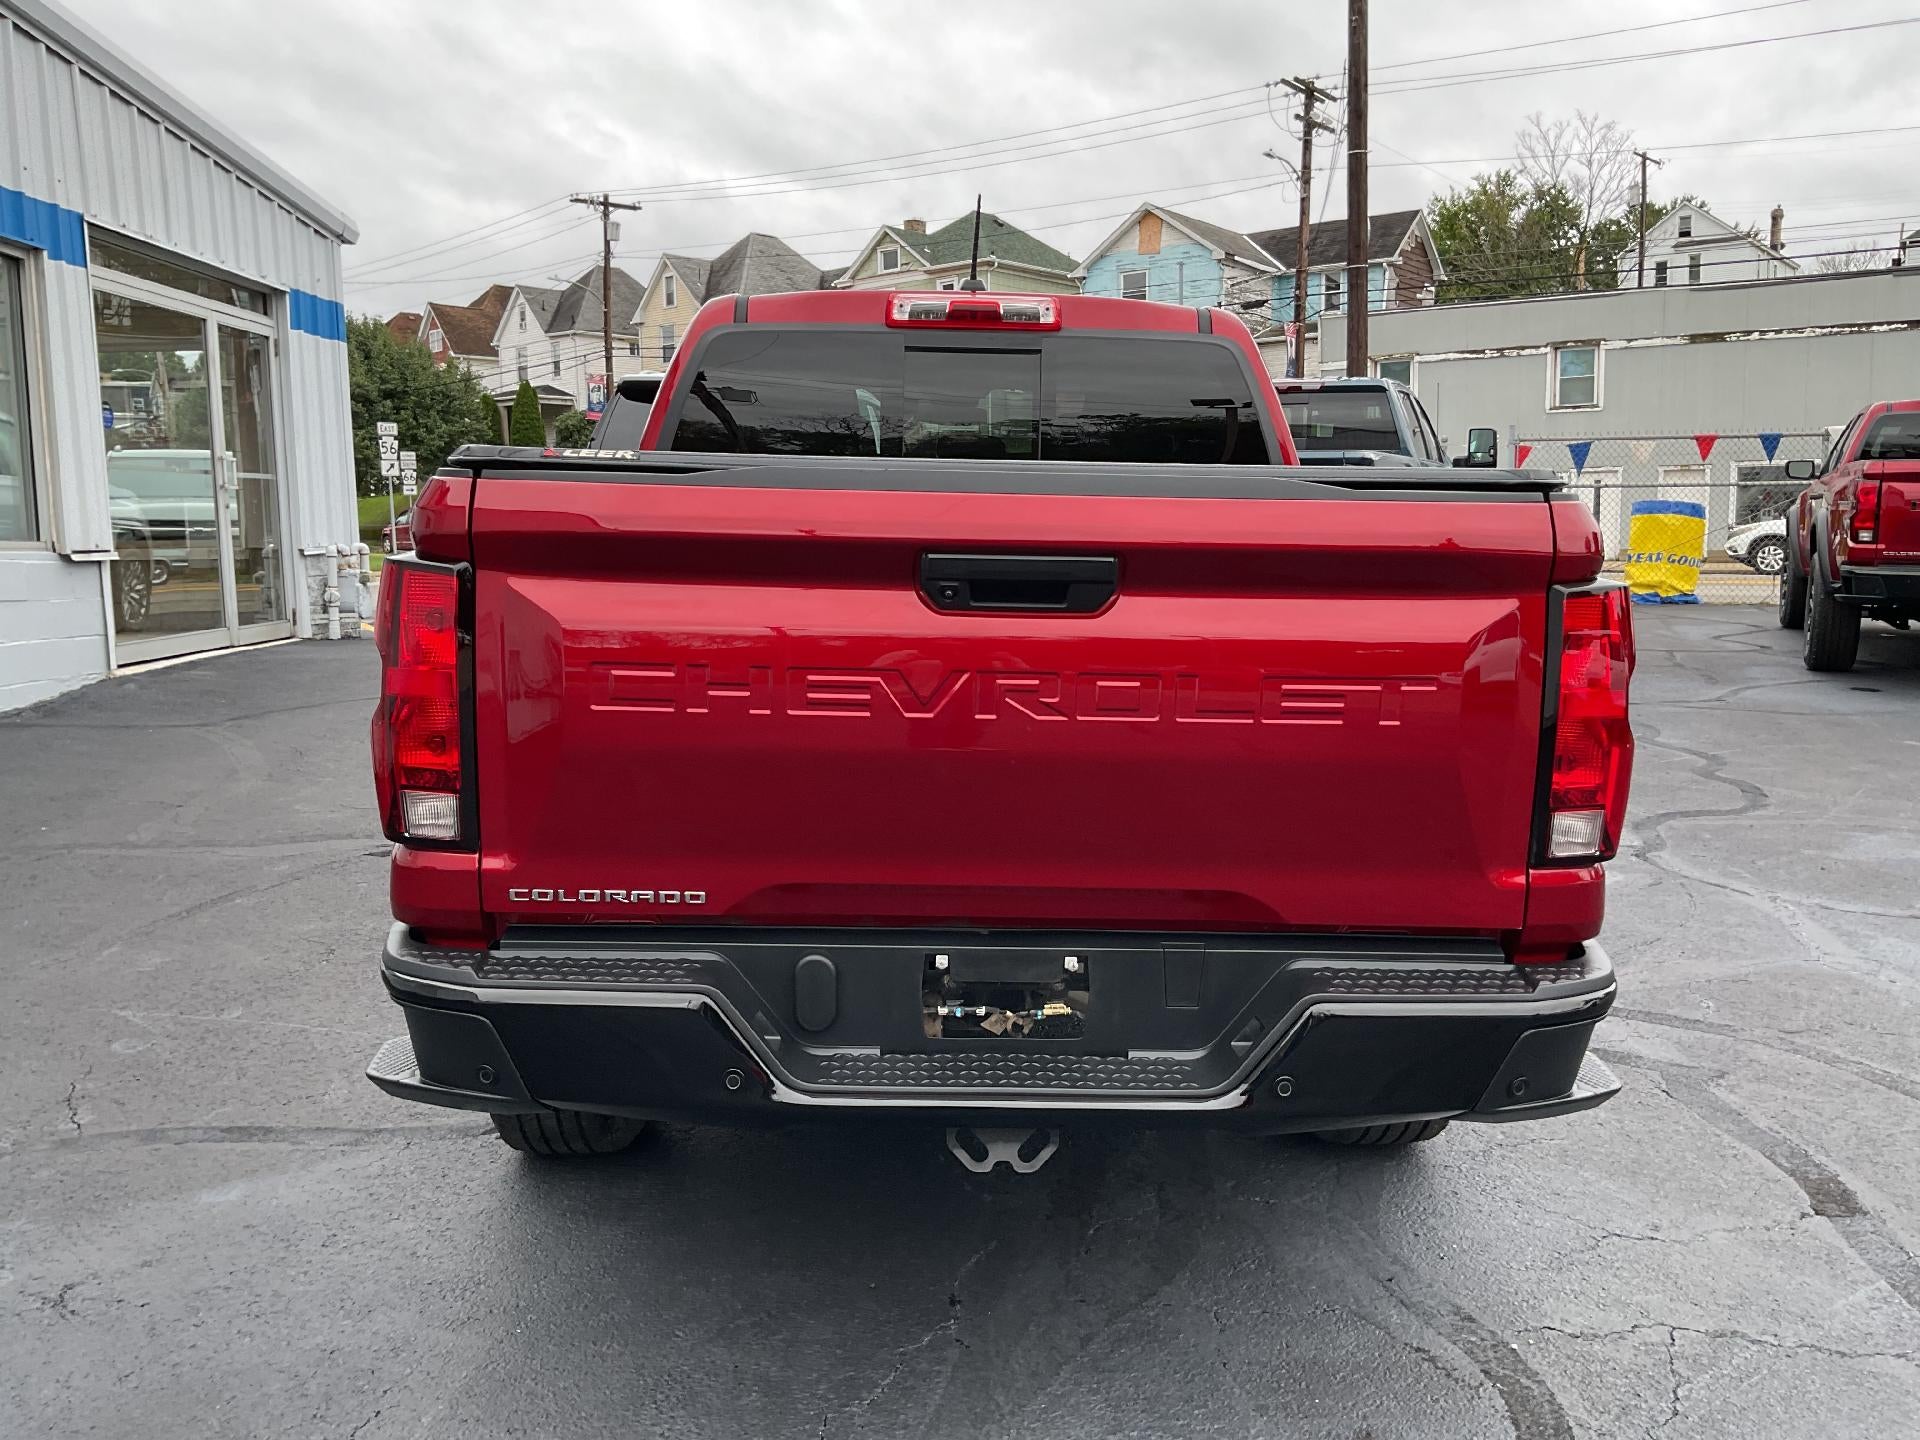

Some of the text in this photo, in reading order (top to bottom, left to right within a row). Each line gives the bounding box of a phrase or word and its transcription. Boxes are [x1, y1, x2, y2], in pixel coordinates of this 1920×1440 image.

[380, 425, 395, 433] EAST
[381, 441, 397, 455] 56
[562, 449, 637, 460] LEER
[403, 473, 416, 482] 66
[1626, 552, 1663, 564] YEAR
[589, 661, 1438, 726] CHEVROLET
[509, 888, 706, 904] COLORADO
